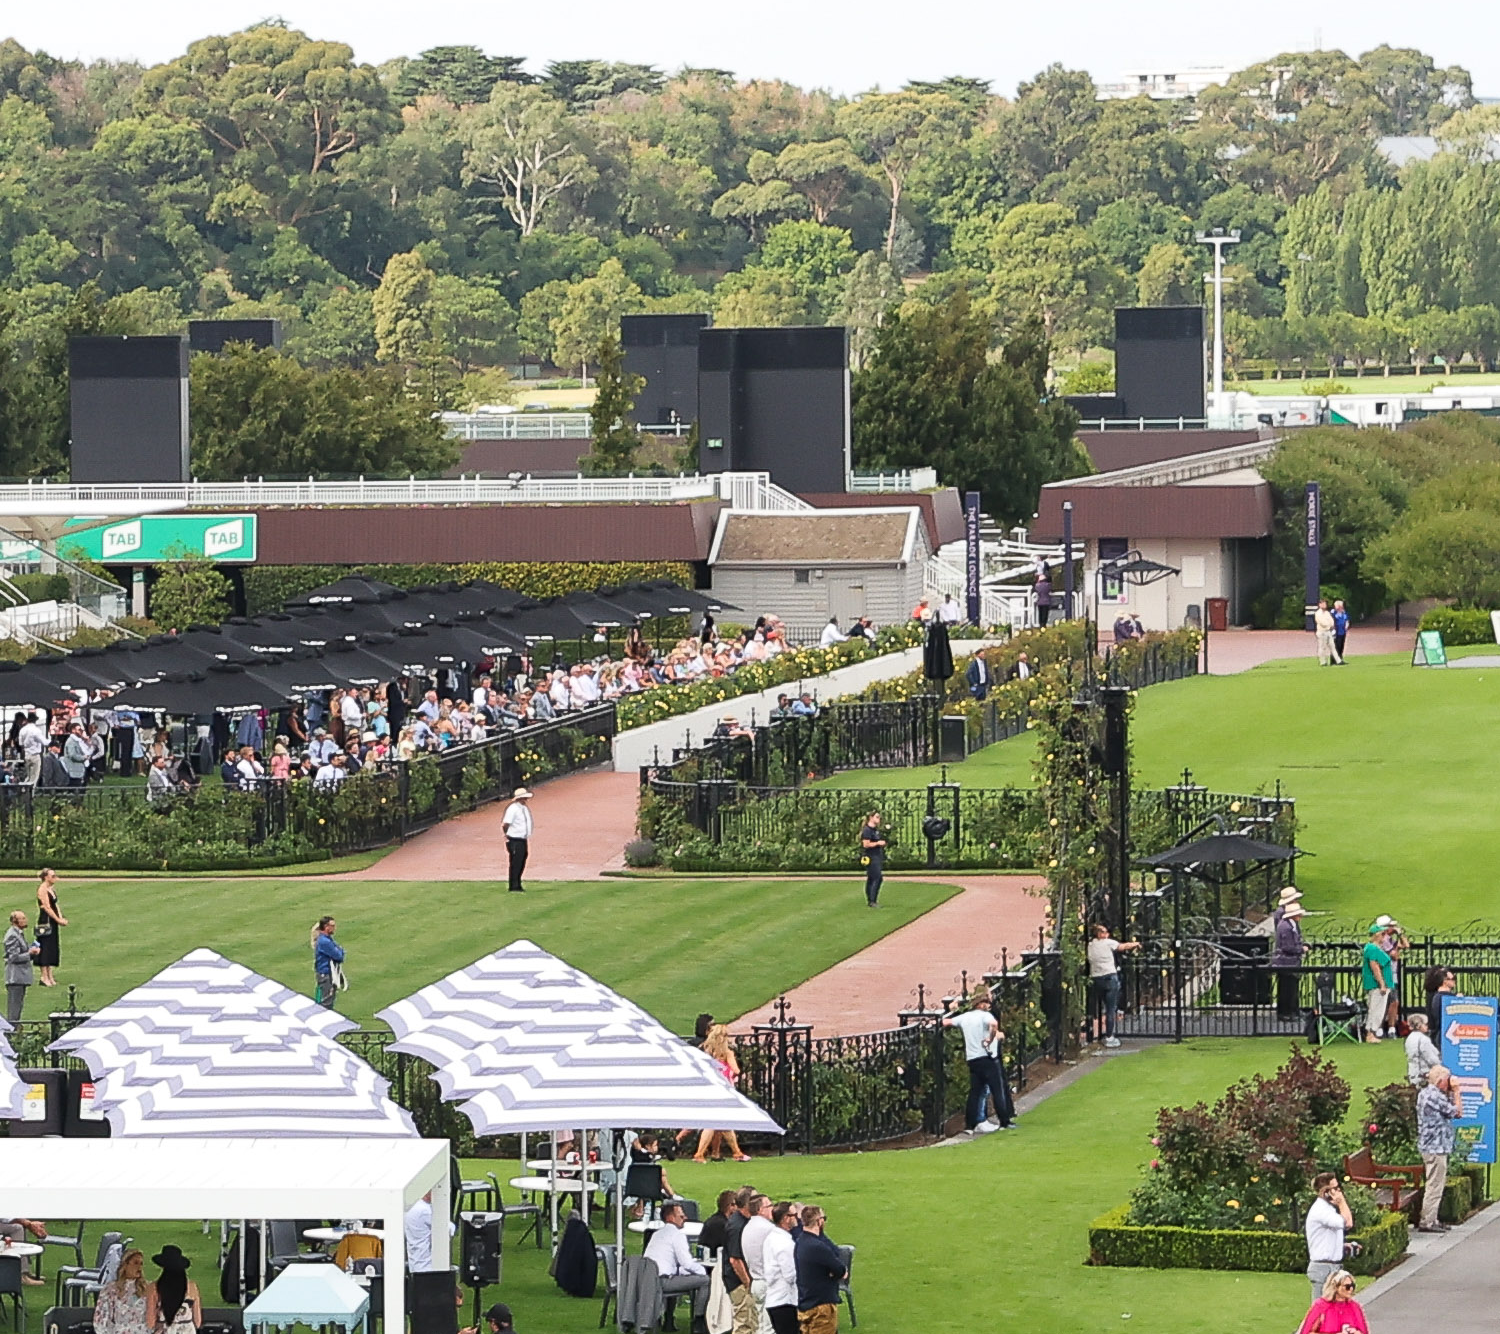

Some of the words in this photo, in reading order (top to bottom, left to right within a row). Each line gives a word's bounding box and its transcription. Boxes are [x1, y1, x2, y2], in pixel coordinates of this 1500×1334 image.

[968, 506, 977, 523] THE
[108, 533, 137, 546] TAB
[209, 532, 238, 545] TAB
[967, 524, 977, 558] PARADE
[968, 560, 977, 598] LOUNGE
